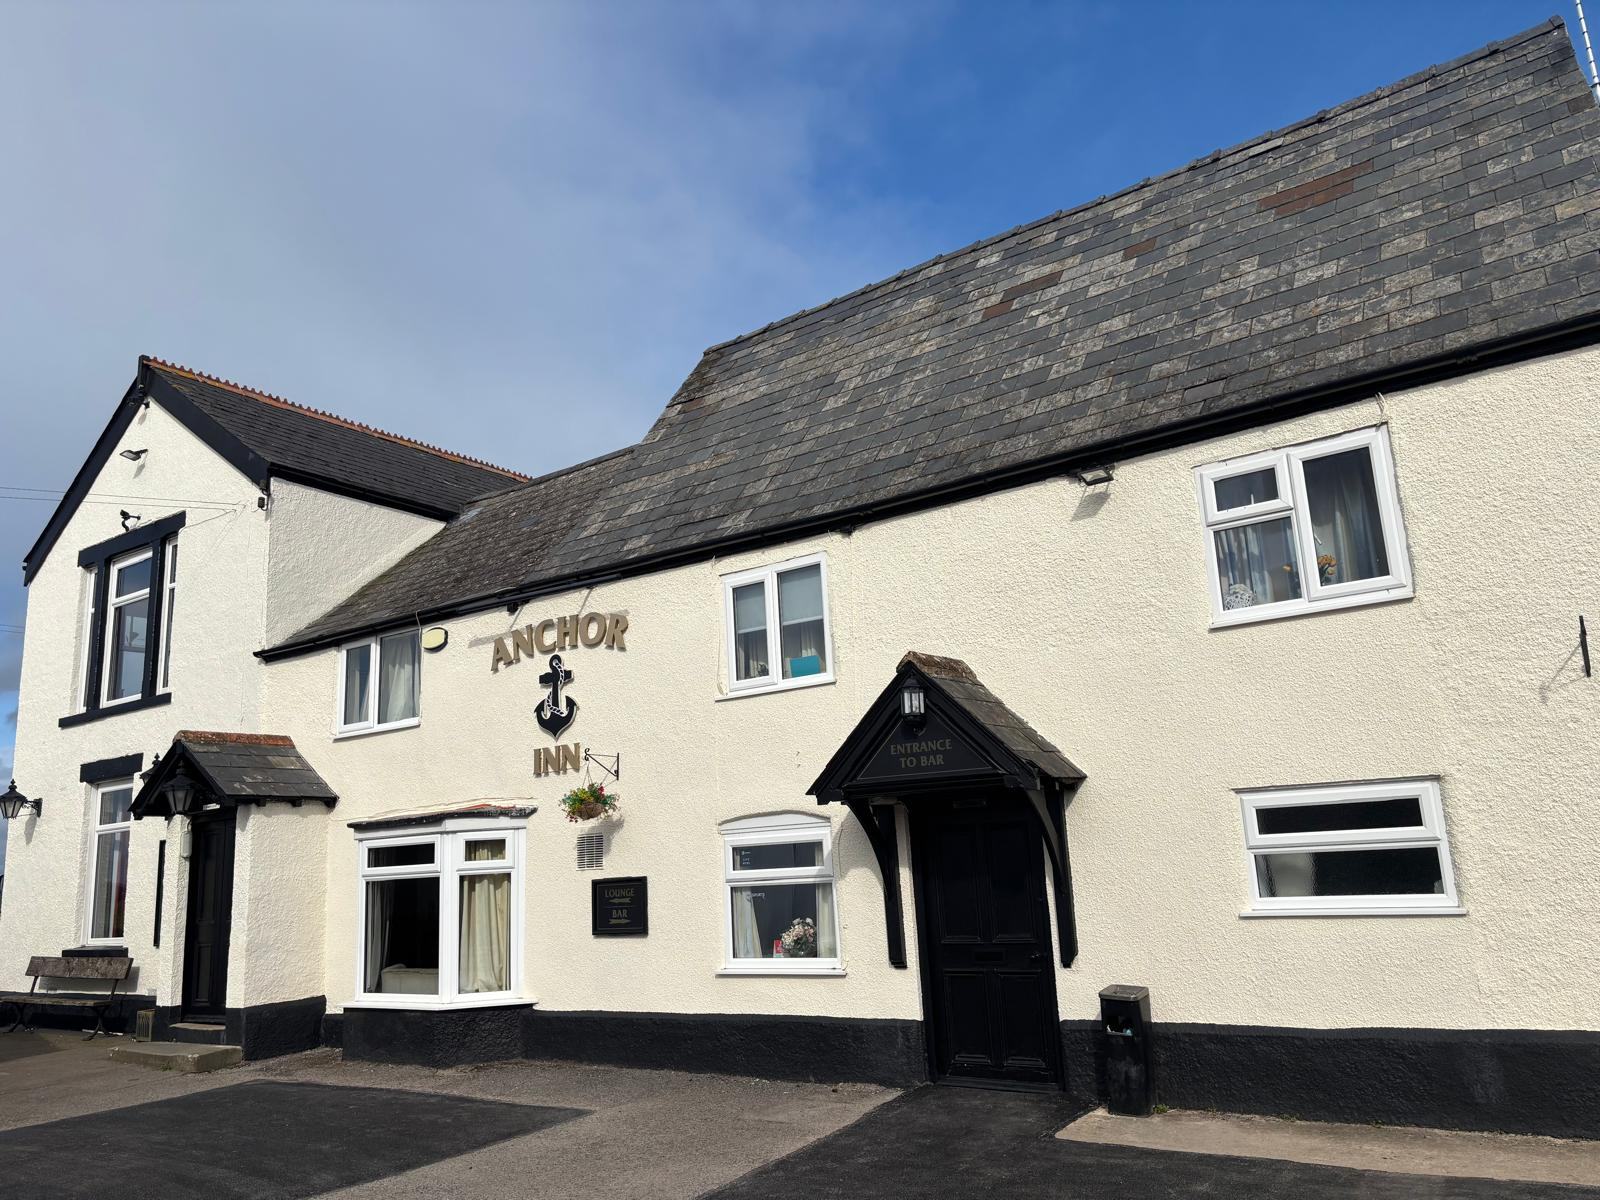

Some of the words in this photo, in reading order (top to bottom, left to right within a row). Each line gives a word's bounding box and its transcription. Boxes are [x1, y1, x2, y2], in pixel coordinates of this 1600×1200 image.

[490, 612, 629, 672] ANCHOR
[890, 739, 953, 755] ENTRANCE
[533, 743, 581, 777] INN
[900, 756, 917, 768] TO
[920, 754, 945, 767] BAR
[604, 887, 635, 898] LOUNGE
[612, 909, 628, 918] BAR
